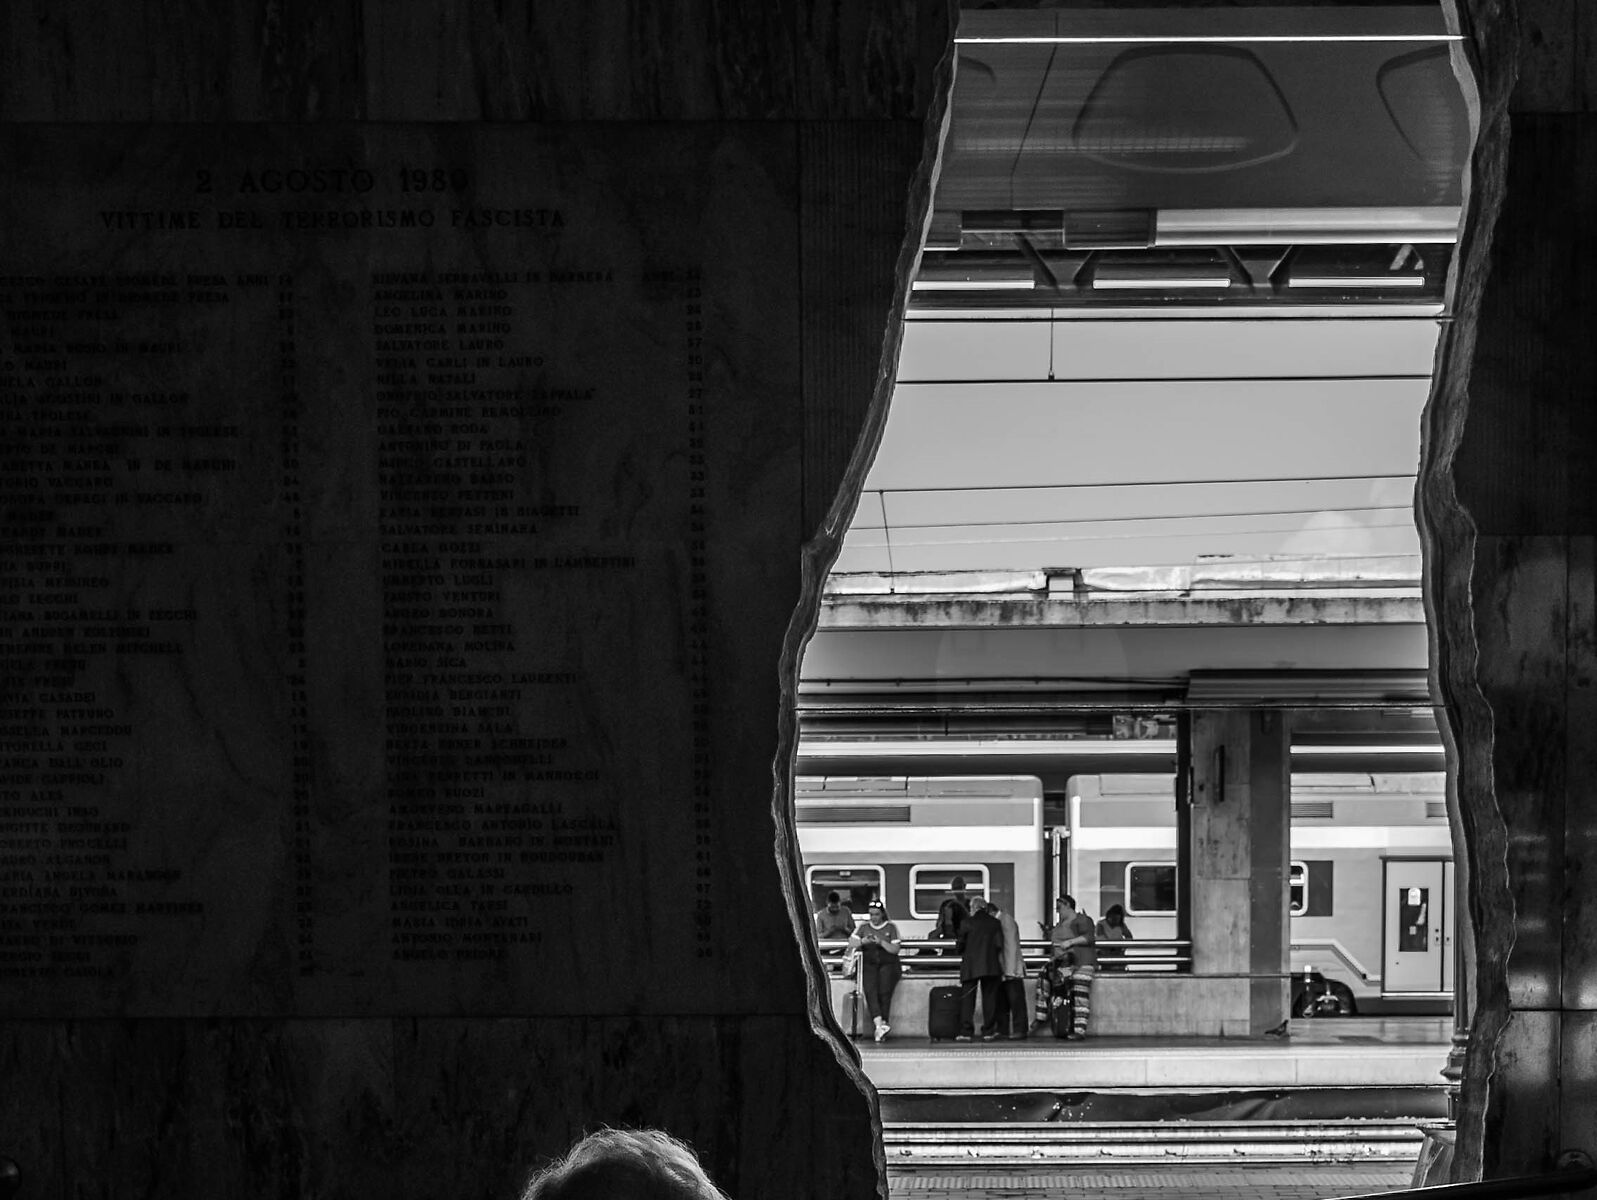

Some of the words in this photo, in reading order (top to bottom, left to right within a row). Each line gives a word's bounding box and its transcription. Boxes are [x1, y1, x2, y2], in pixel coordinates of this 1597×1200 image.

[196, 169, 213, 193] 2
[238, 168, 375, 193] AGOSTO
[399, 167, 470, 193] 1980
[100, 210, 201, 229] VITTIME
[218, 210, 264, 229] DEL
[281, 209, 436, 229] TERRORISMO
[451, 208, 566, 228] FASCISTA
